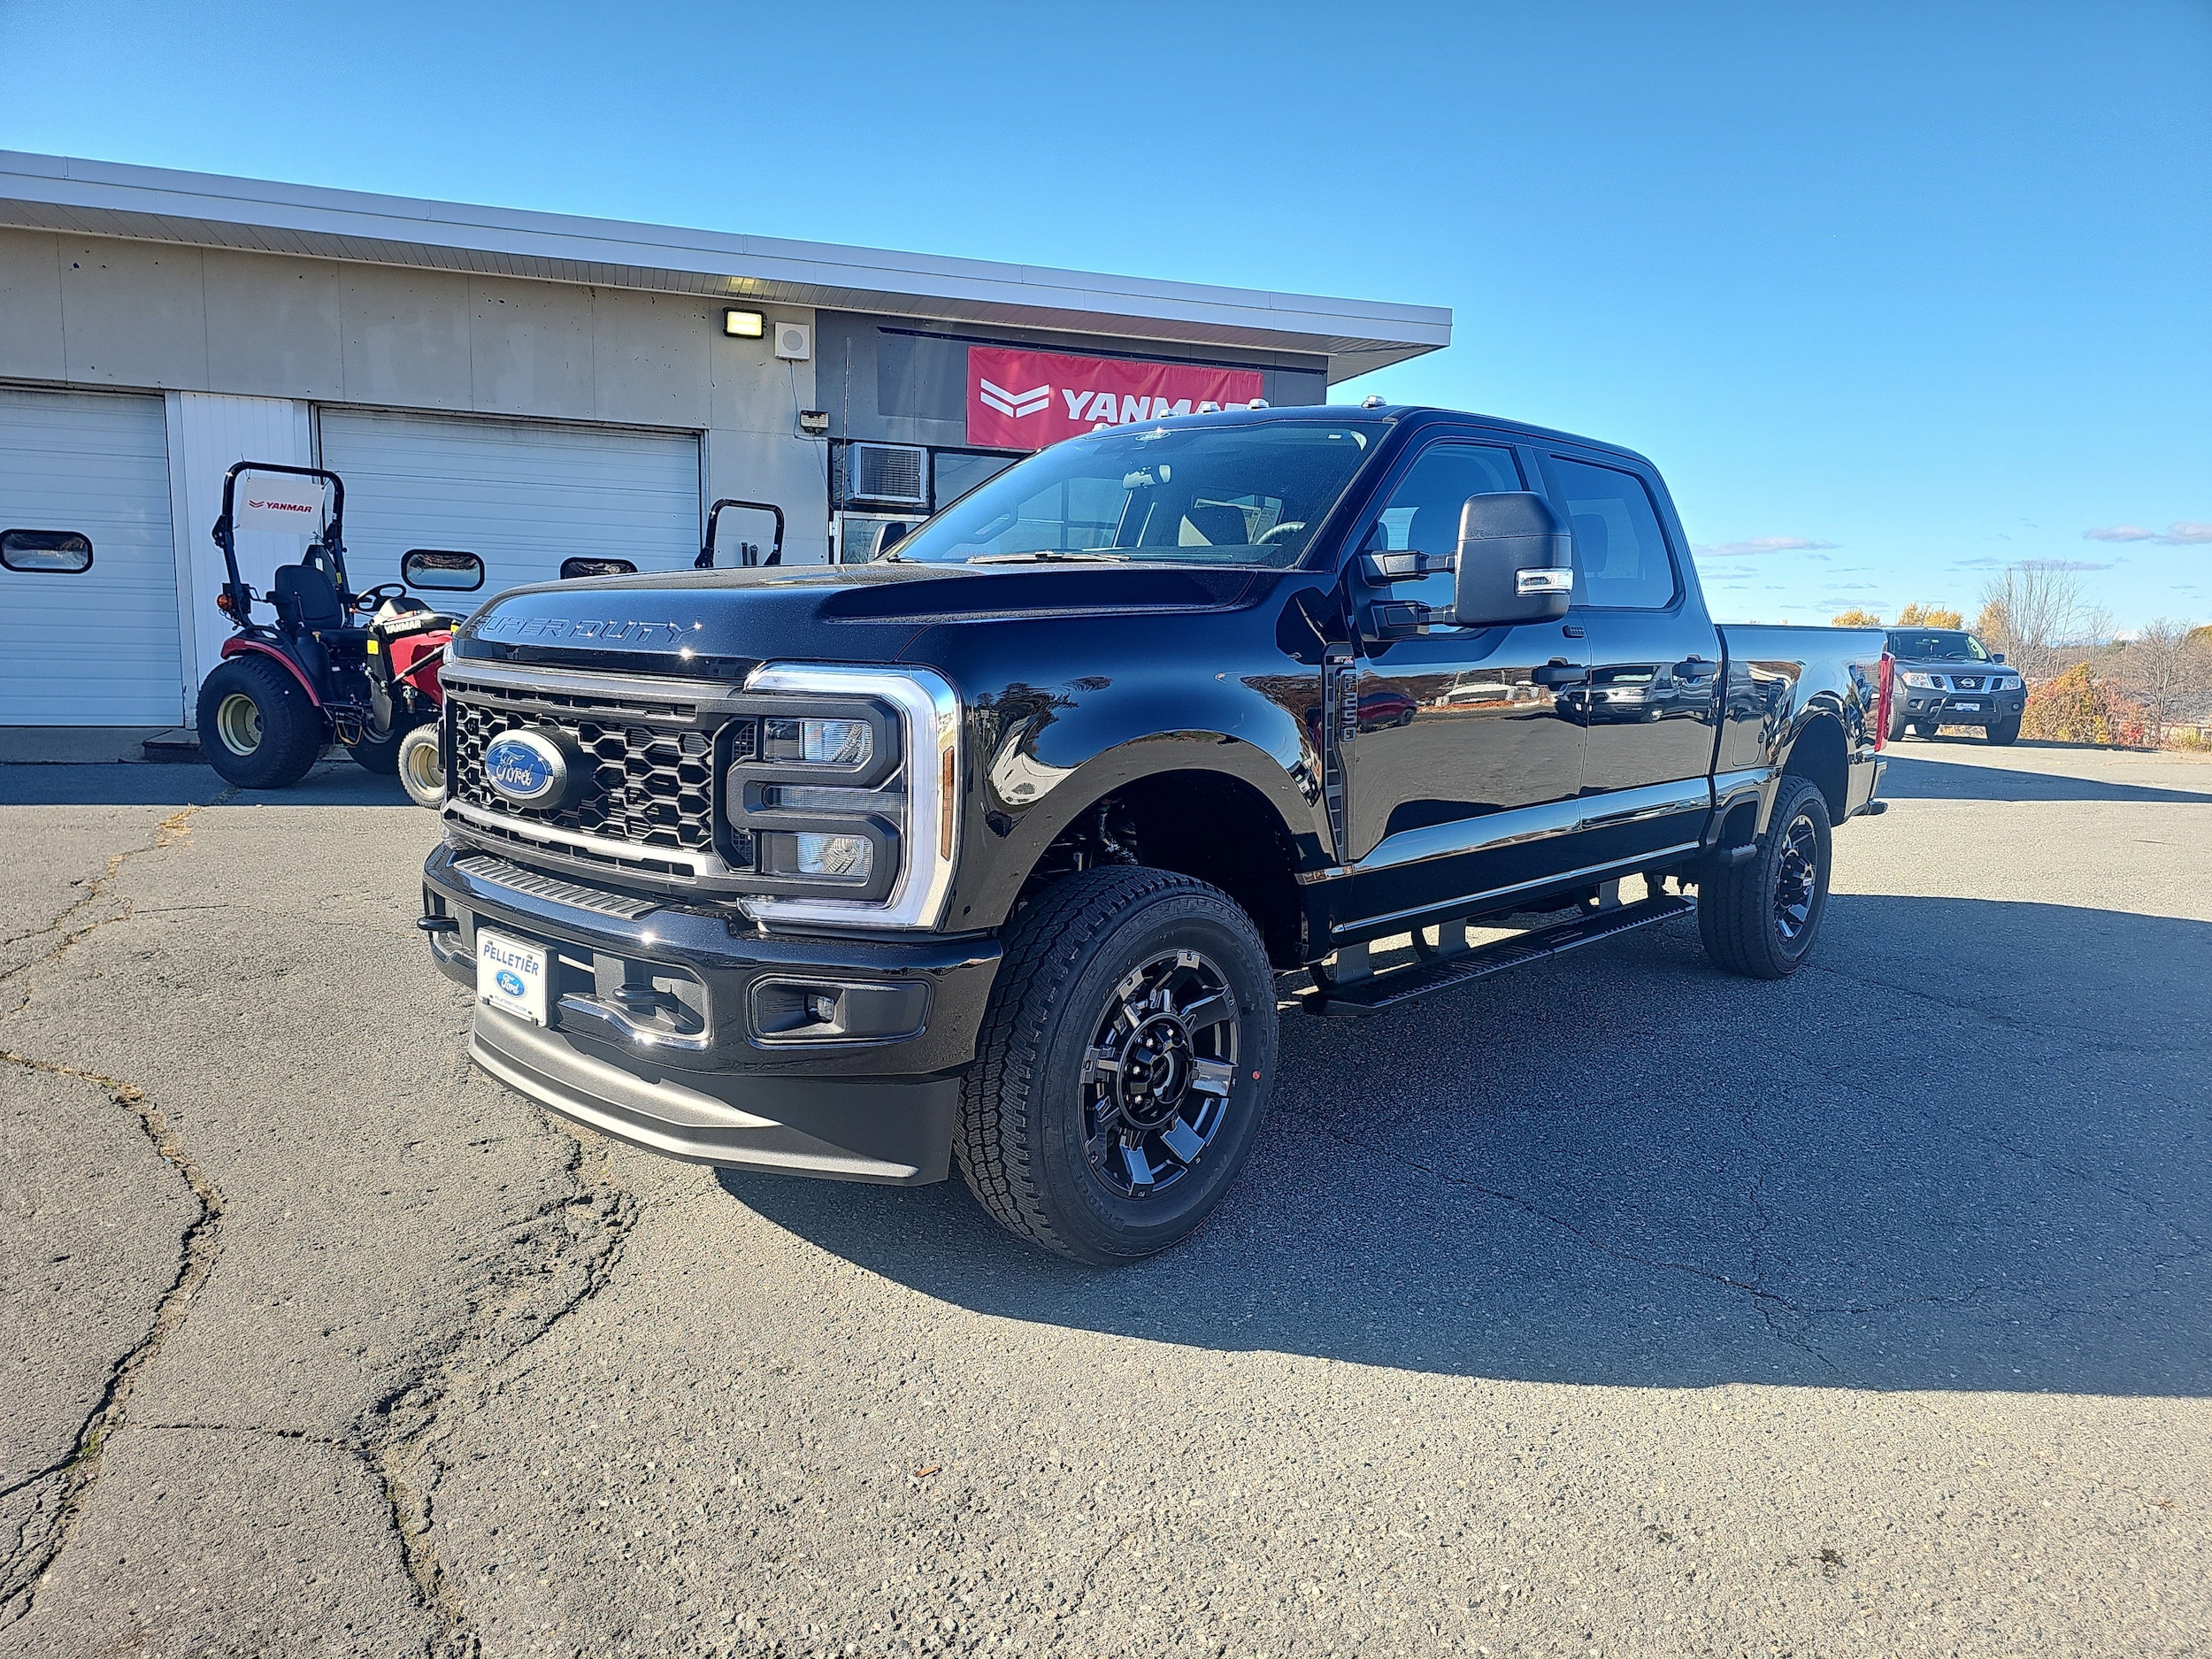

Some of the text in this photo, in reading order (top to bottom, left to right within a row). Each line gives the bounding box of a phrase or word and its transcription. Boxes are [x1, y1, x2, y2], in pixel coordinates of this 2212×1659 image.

[1062, 388, 1248, 425] YANM
[266, 502, 312, 513] YANMAR
[384, 619, 422, 634] YANMAR
[467, 614, 701, 643] SUPER DUTY
[496, 747, 534, 787] Ford
[483, 944, 539, 976] PELLETIER
[500, 973, 520, 995] Ford
